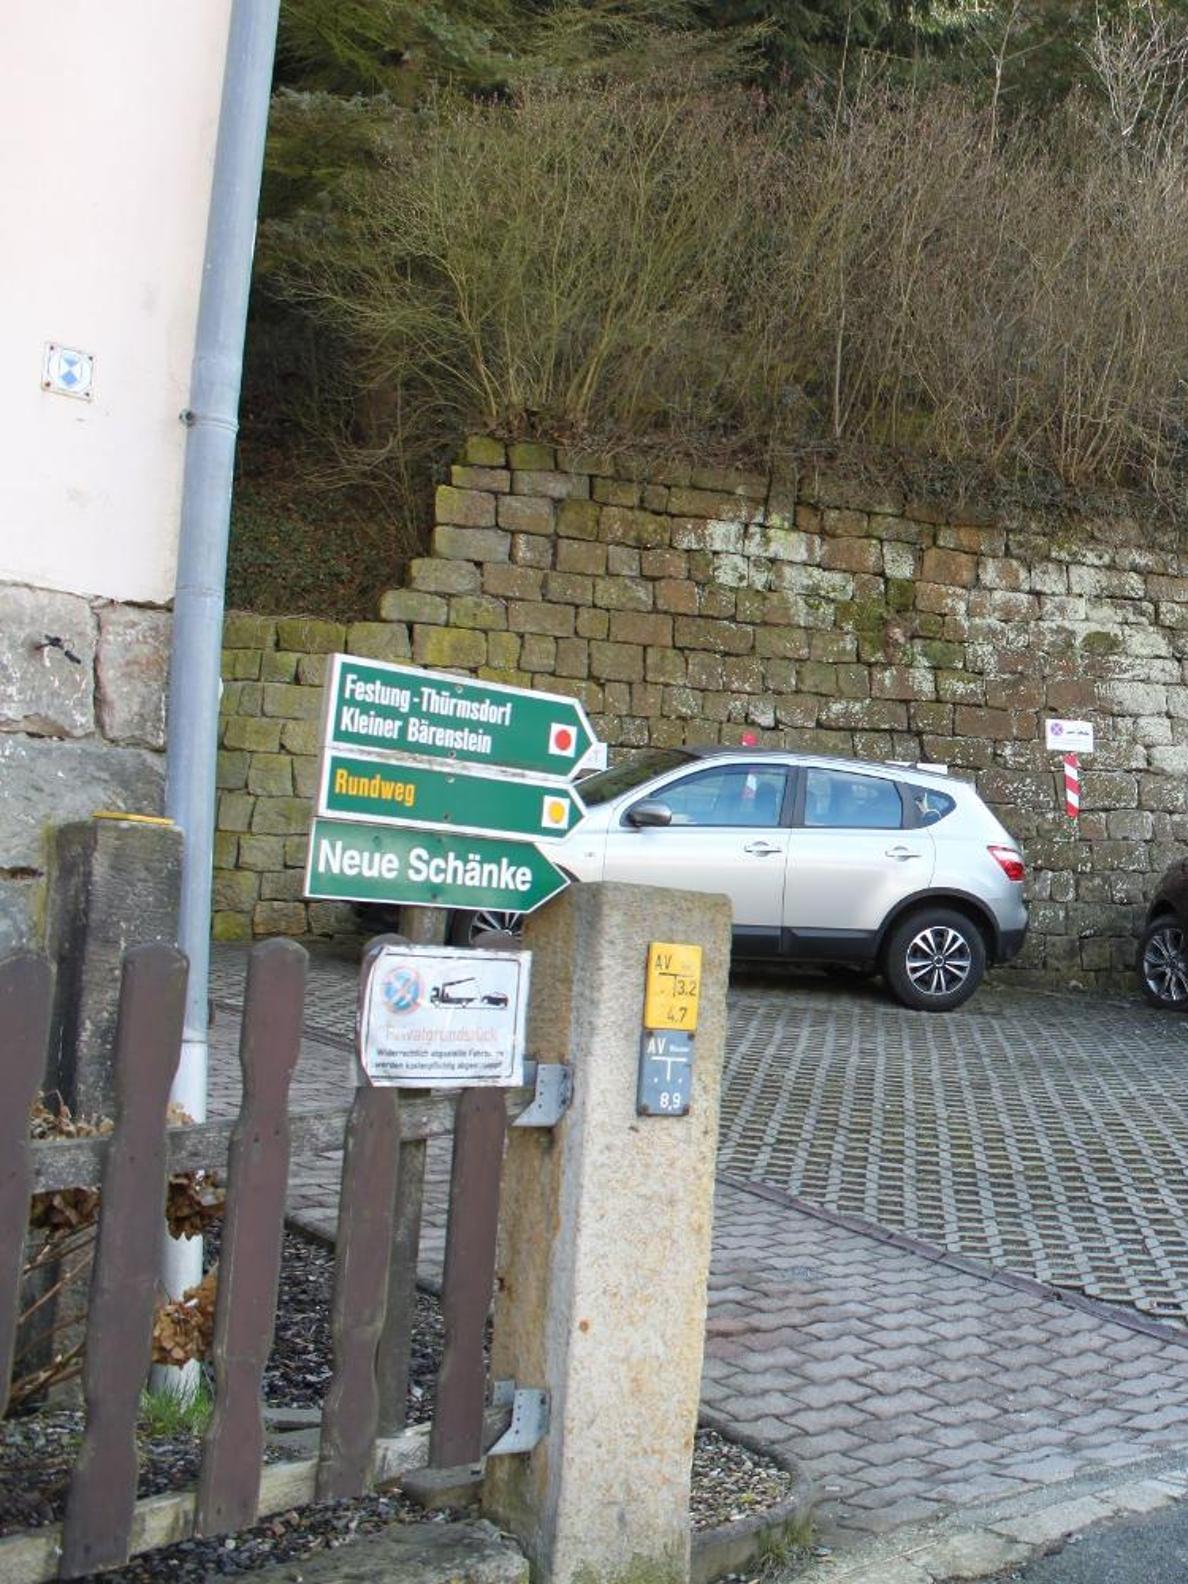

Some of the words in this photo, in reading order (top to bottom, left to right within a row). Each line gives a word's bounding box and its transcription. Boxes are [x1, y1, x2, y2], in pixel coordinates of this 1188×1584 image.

[340, 706, 402, 740] Kleiner
[407, 718, 493, 755] Bärenstein
[335, 768, 416, 807] Rundweg
[318, 839, 400, 880] Neue
[408, 847, 533, 892] Schänke
[655, 954, 673, 971] AV
[647, 1037, 666, 1054] AV
